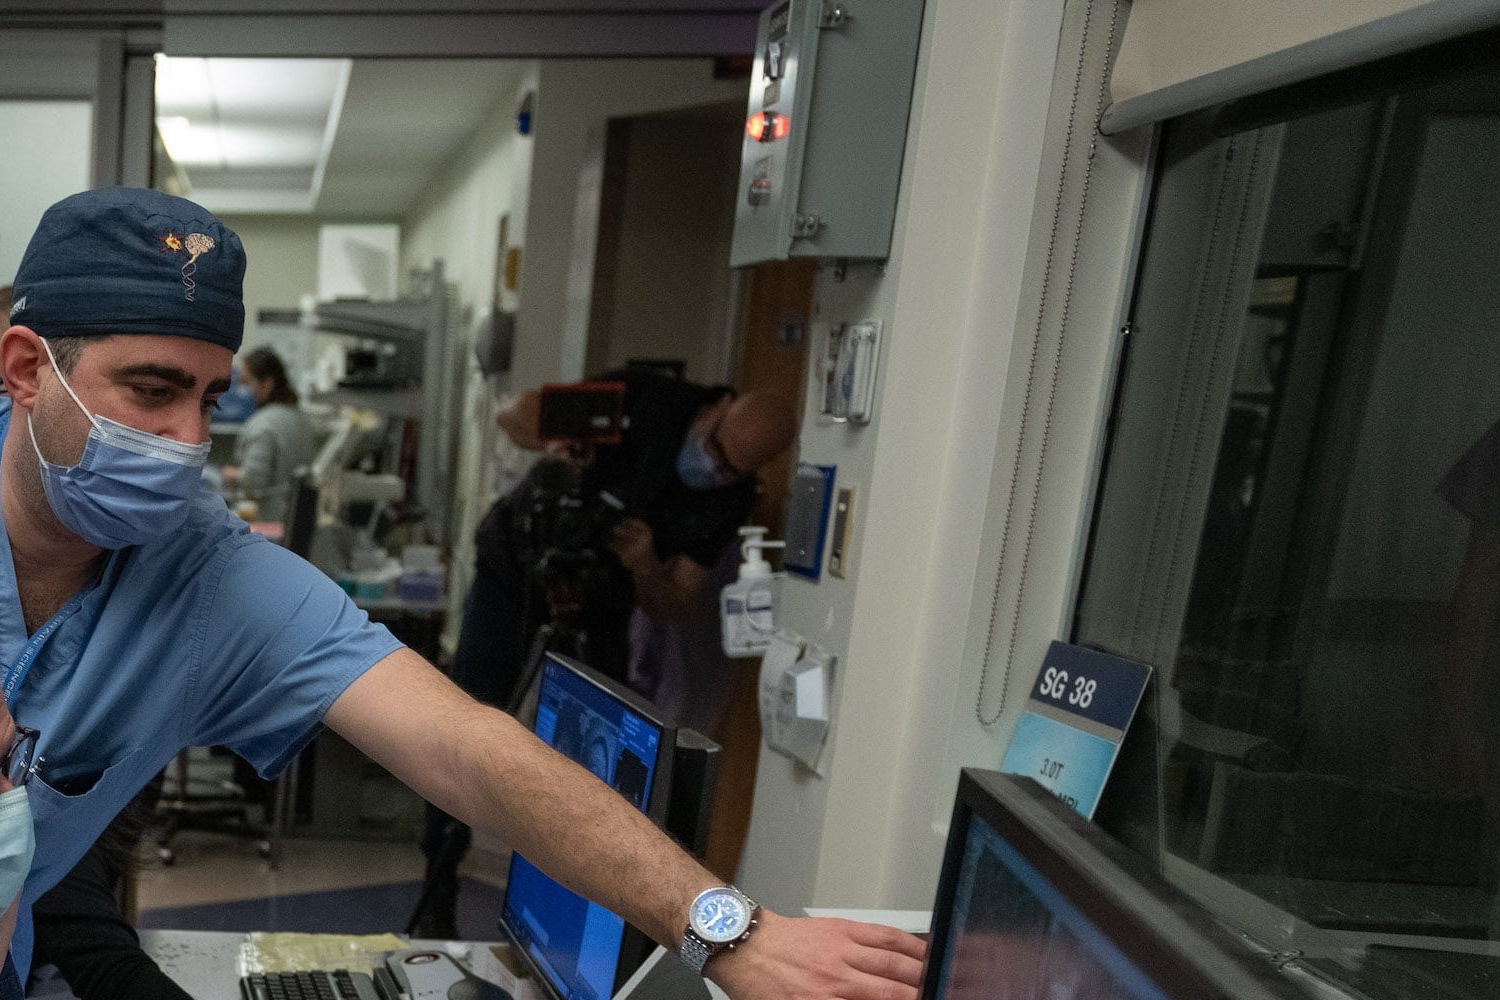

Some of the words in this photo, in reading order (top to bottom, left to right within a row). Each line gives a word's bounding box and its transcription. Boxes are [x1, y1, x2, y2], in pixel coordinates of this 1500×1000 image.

[1040, 667, 1068, 699] SG
[1069, 676, 1097, 708] 38
[1040, 758, 1064, 781] 3.0T
